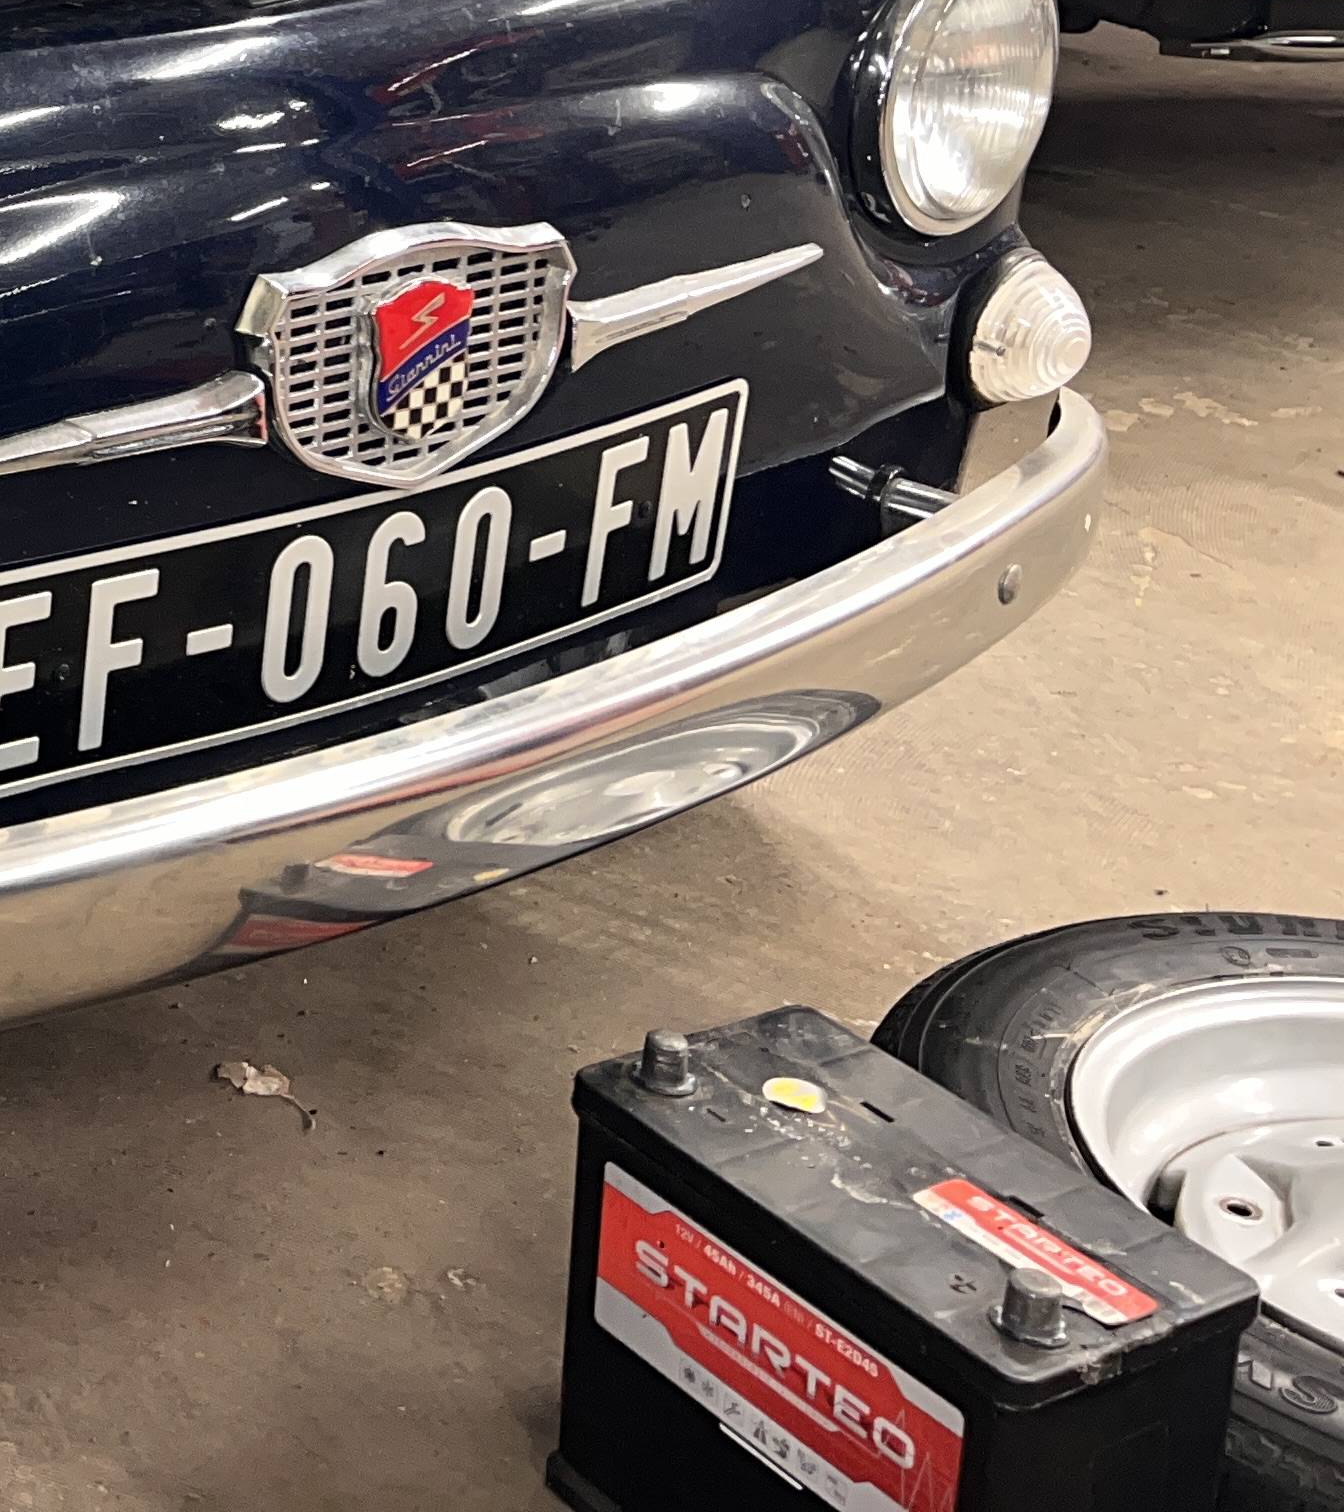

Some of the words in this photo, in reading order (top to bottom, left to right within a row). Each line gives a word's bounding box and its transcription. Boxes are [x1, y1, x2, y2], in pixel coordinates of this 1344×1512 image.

[387, 334, 461, 397] Giannini
[675, 1224, 694, 1244] 12V
[703, 1244, 737, 1276] 45Ah
[746, 1274, 781, 1308] 345A
[966, 1195, 1128, 1297] STARTEO
[635, 1239, 917, 1470] STARTEO
